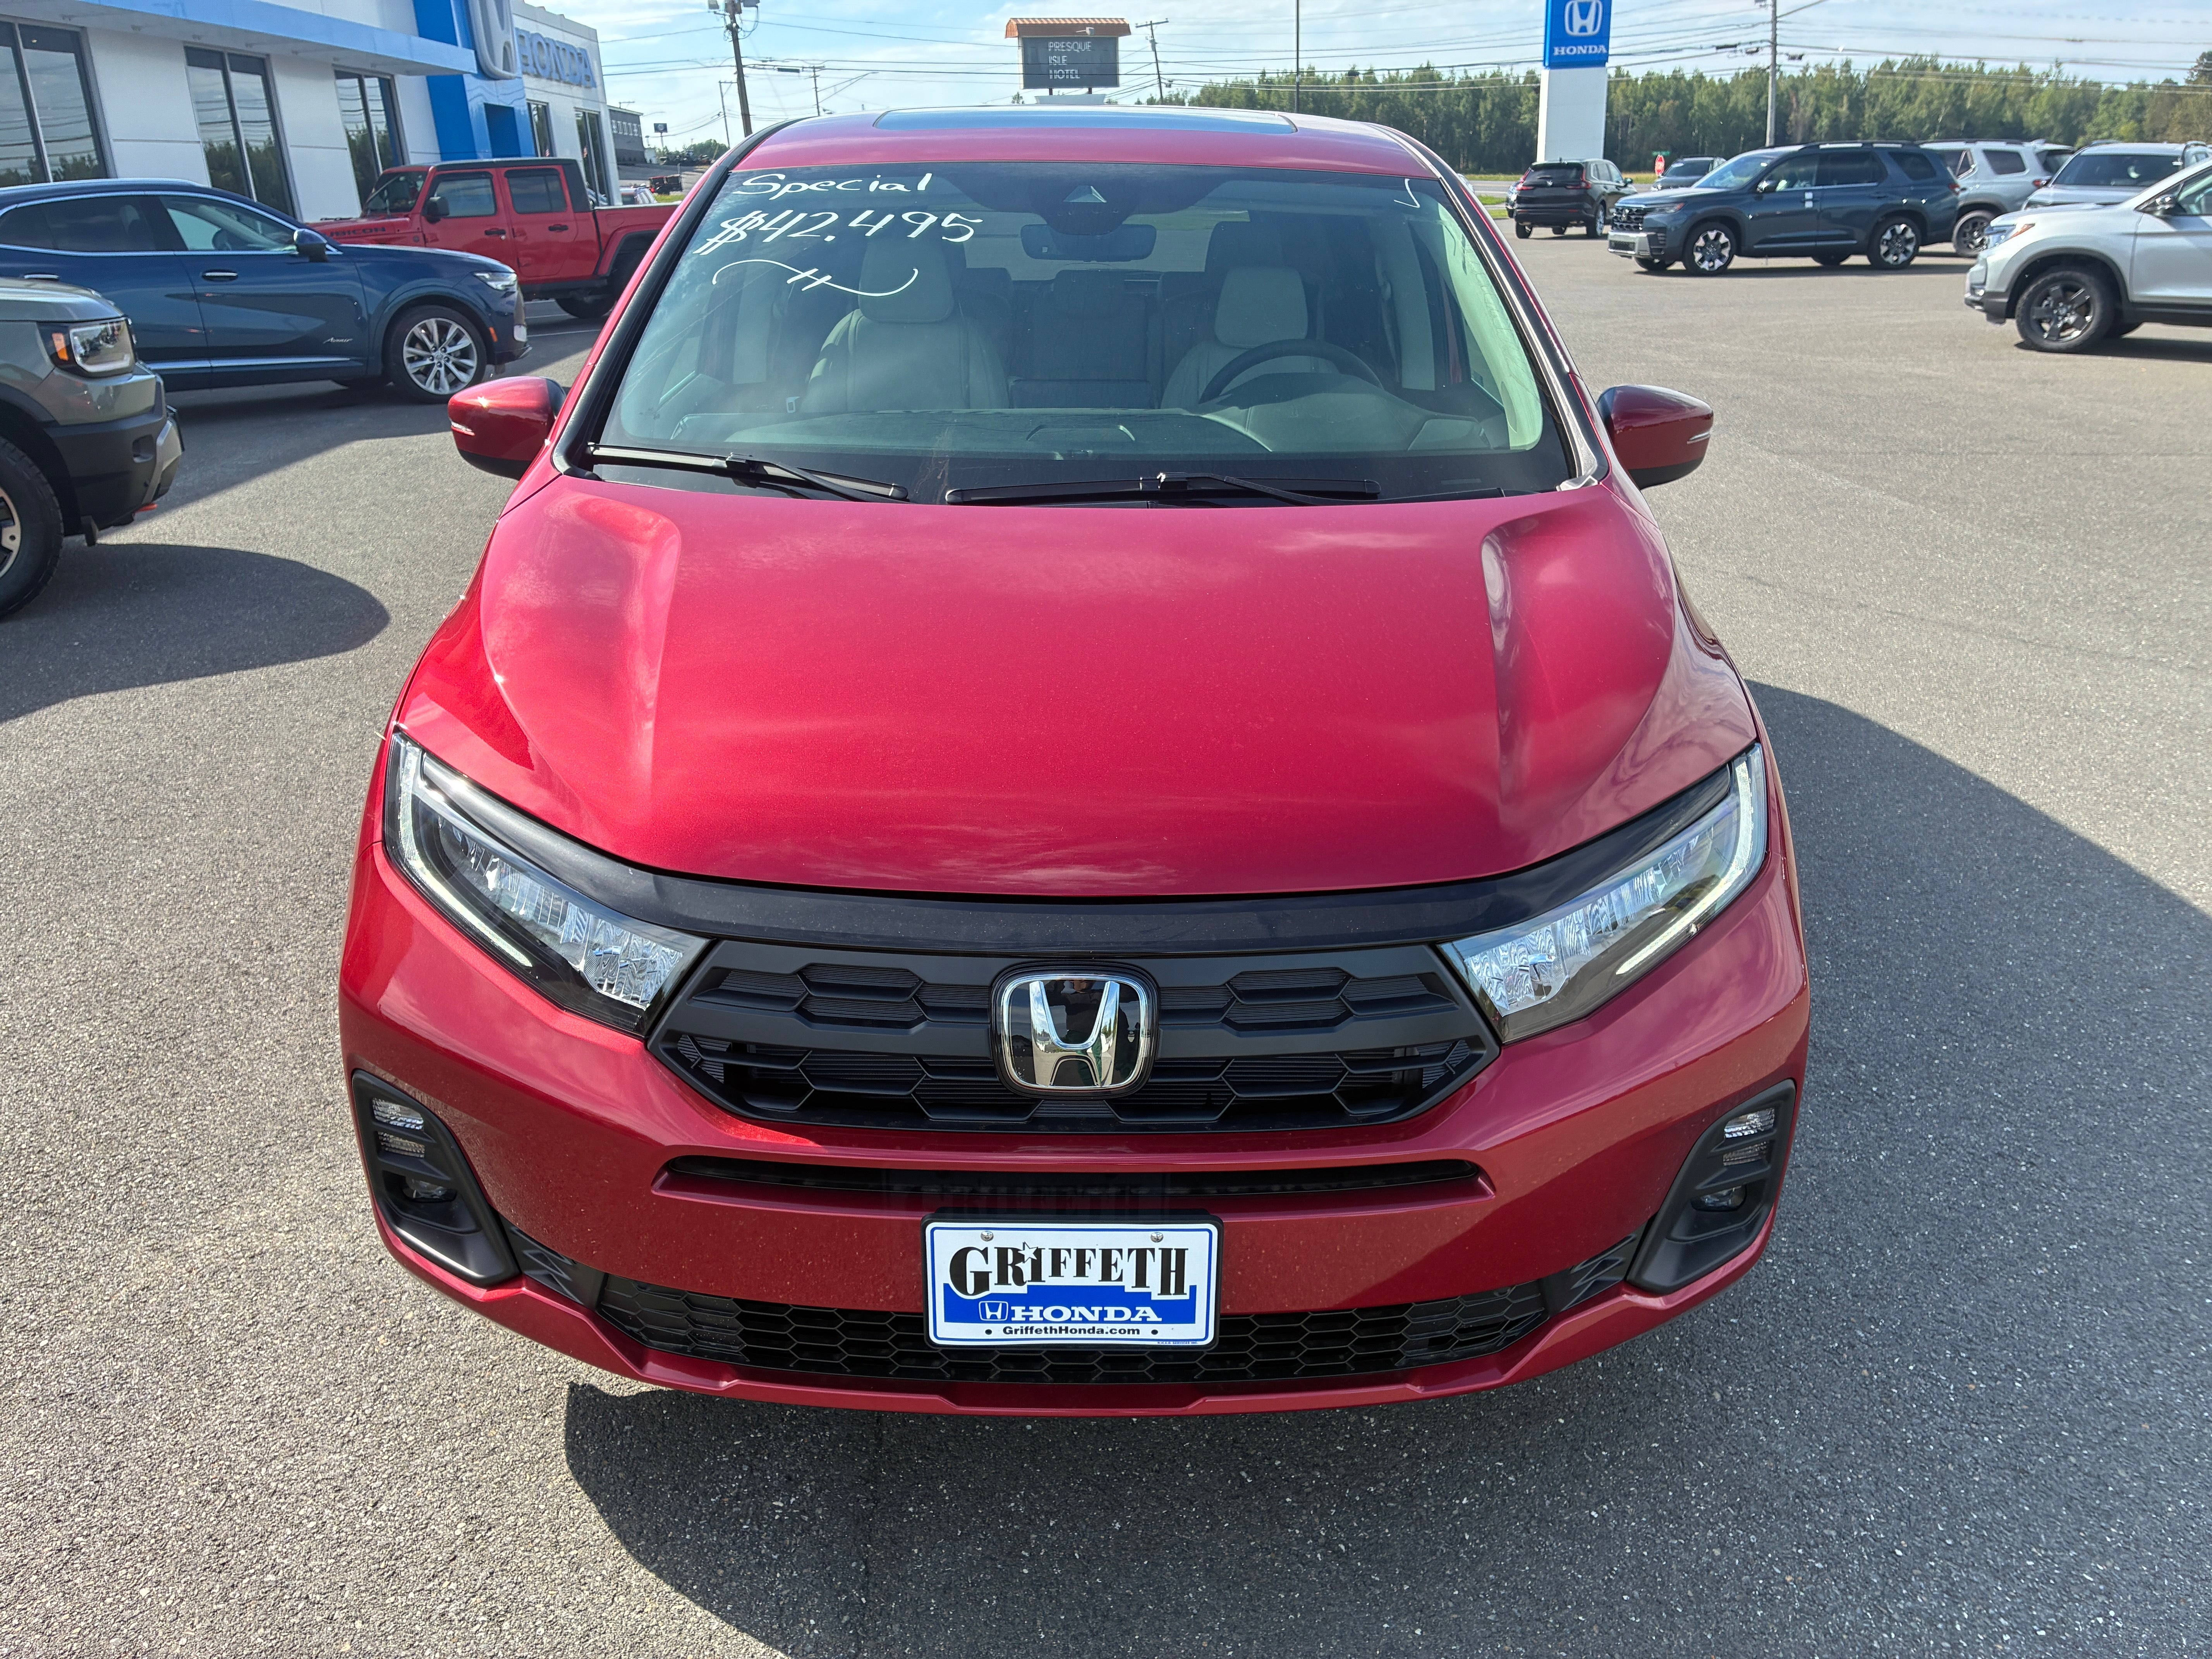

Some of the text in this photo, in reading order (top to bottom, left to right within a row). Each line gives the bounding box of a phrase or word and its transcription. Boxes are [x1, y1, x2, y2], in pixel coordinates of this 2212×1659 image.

[1048, 41, 1092, 53] PRESQUE
[1553, 44, 1607, 55] HONDA
[515, 27, 597, 89] HONDA
[1049, 55, 1068, 65] ISLE
[1049, 69, 1080, 79] HOTEL
[732, 173, 933, 200] Special
[949, 1245, 1189, 1297] GRIFFETH
[1011, 1305, 1163, 1322] HONDA
[1002, 1326, 1140, 1336] GriffethHonda.com
